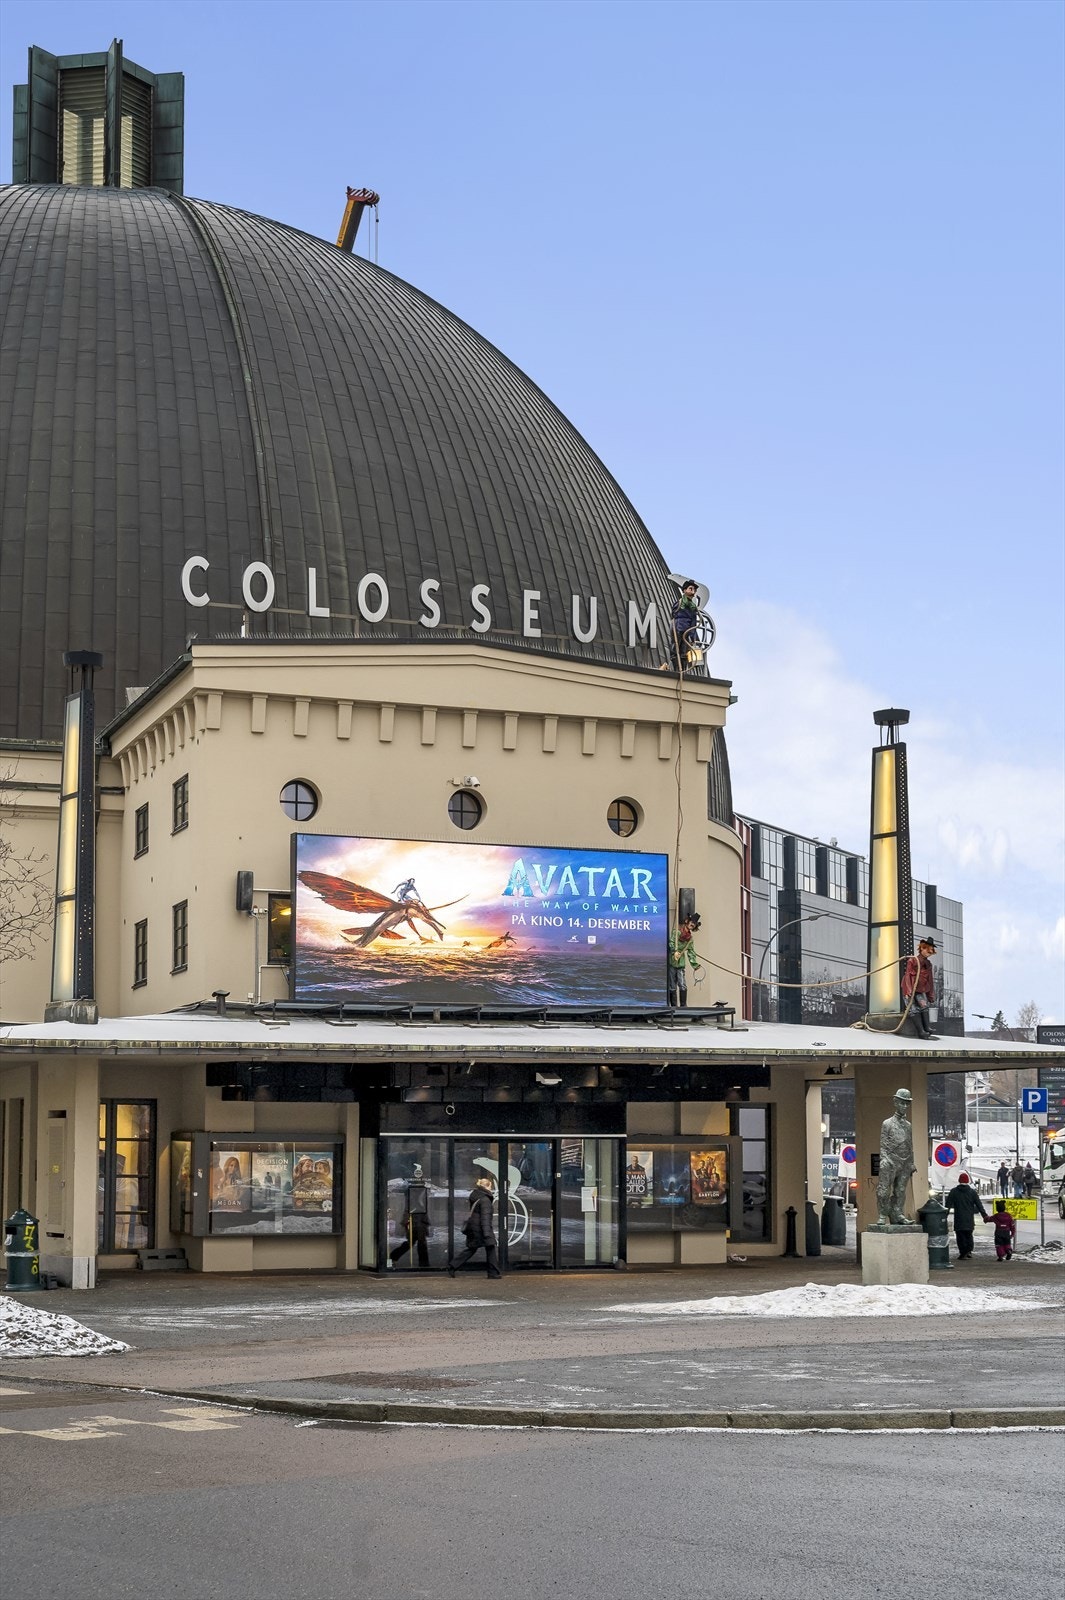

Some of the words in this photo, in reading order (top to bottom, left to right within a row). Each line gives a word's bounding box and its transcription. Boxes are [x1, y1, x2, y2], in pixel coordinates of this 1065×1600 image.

[180, 555, 658, 650] COLOSSEUM
[501, 857, 659, 902] AVATAR
[502, 900, 530, 908] THE
[542, 900, 570, 910] WAY
[582, 902, 599, 911] OF
[611, 903, 658, 914] WATER
[511, 912, 527, 926] PÅ
[531, 915, 564, 927] KINO
[567, 917, 584, 928] 14.
[588, 917, 651, 931] DESEMBER
[1028, 1091, 1042, 1110] P
[626, 1184, 646, 1193] OTTO
